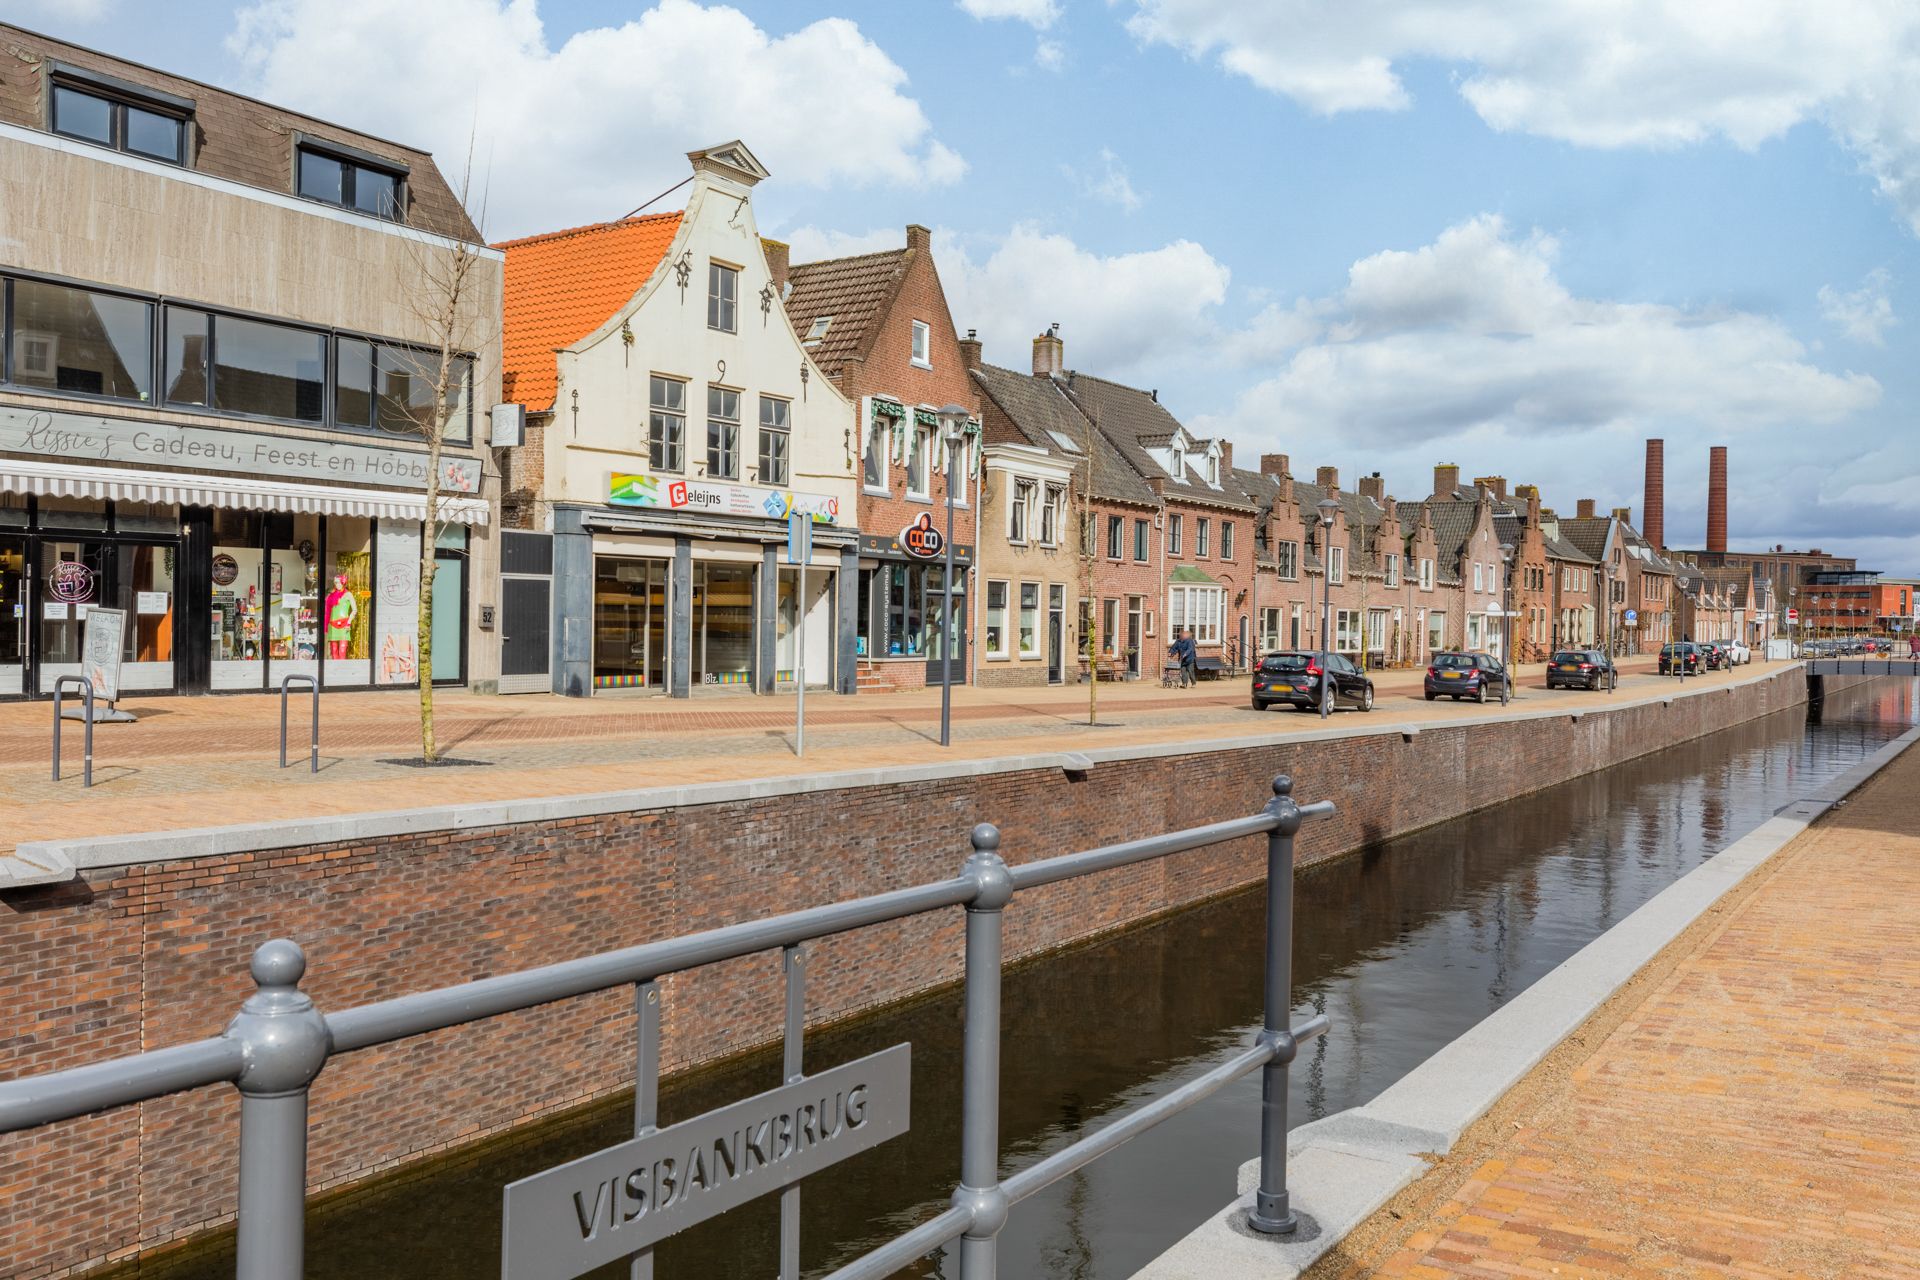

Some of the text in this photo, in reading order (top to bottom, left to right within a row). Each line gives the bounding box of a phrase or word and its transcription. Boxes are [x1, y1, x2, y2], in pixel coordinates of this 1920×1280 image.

[132, 432, 241, 463] Cadeau,
[254, 444, 317, 468] Feest
[328, 457, 355, 472] en
[671, 484, 721, 508] Geleijns
[483, 611, 492, 623] 52
[573, 1083, 868, 1242] VISBANKBRUG
